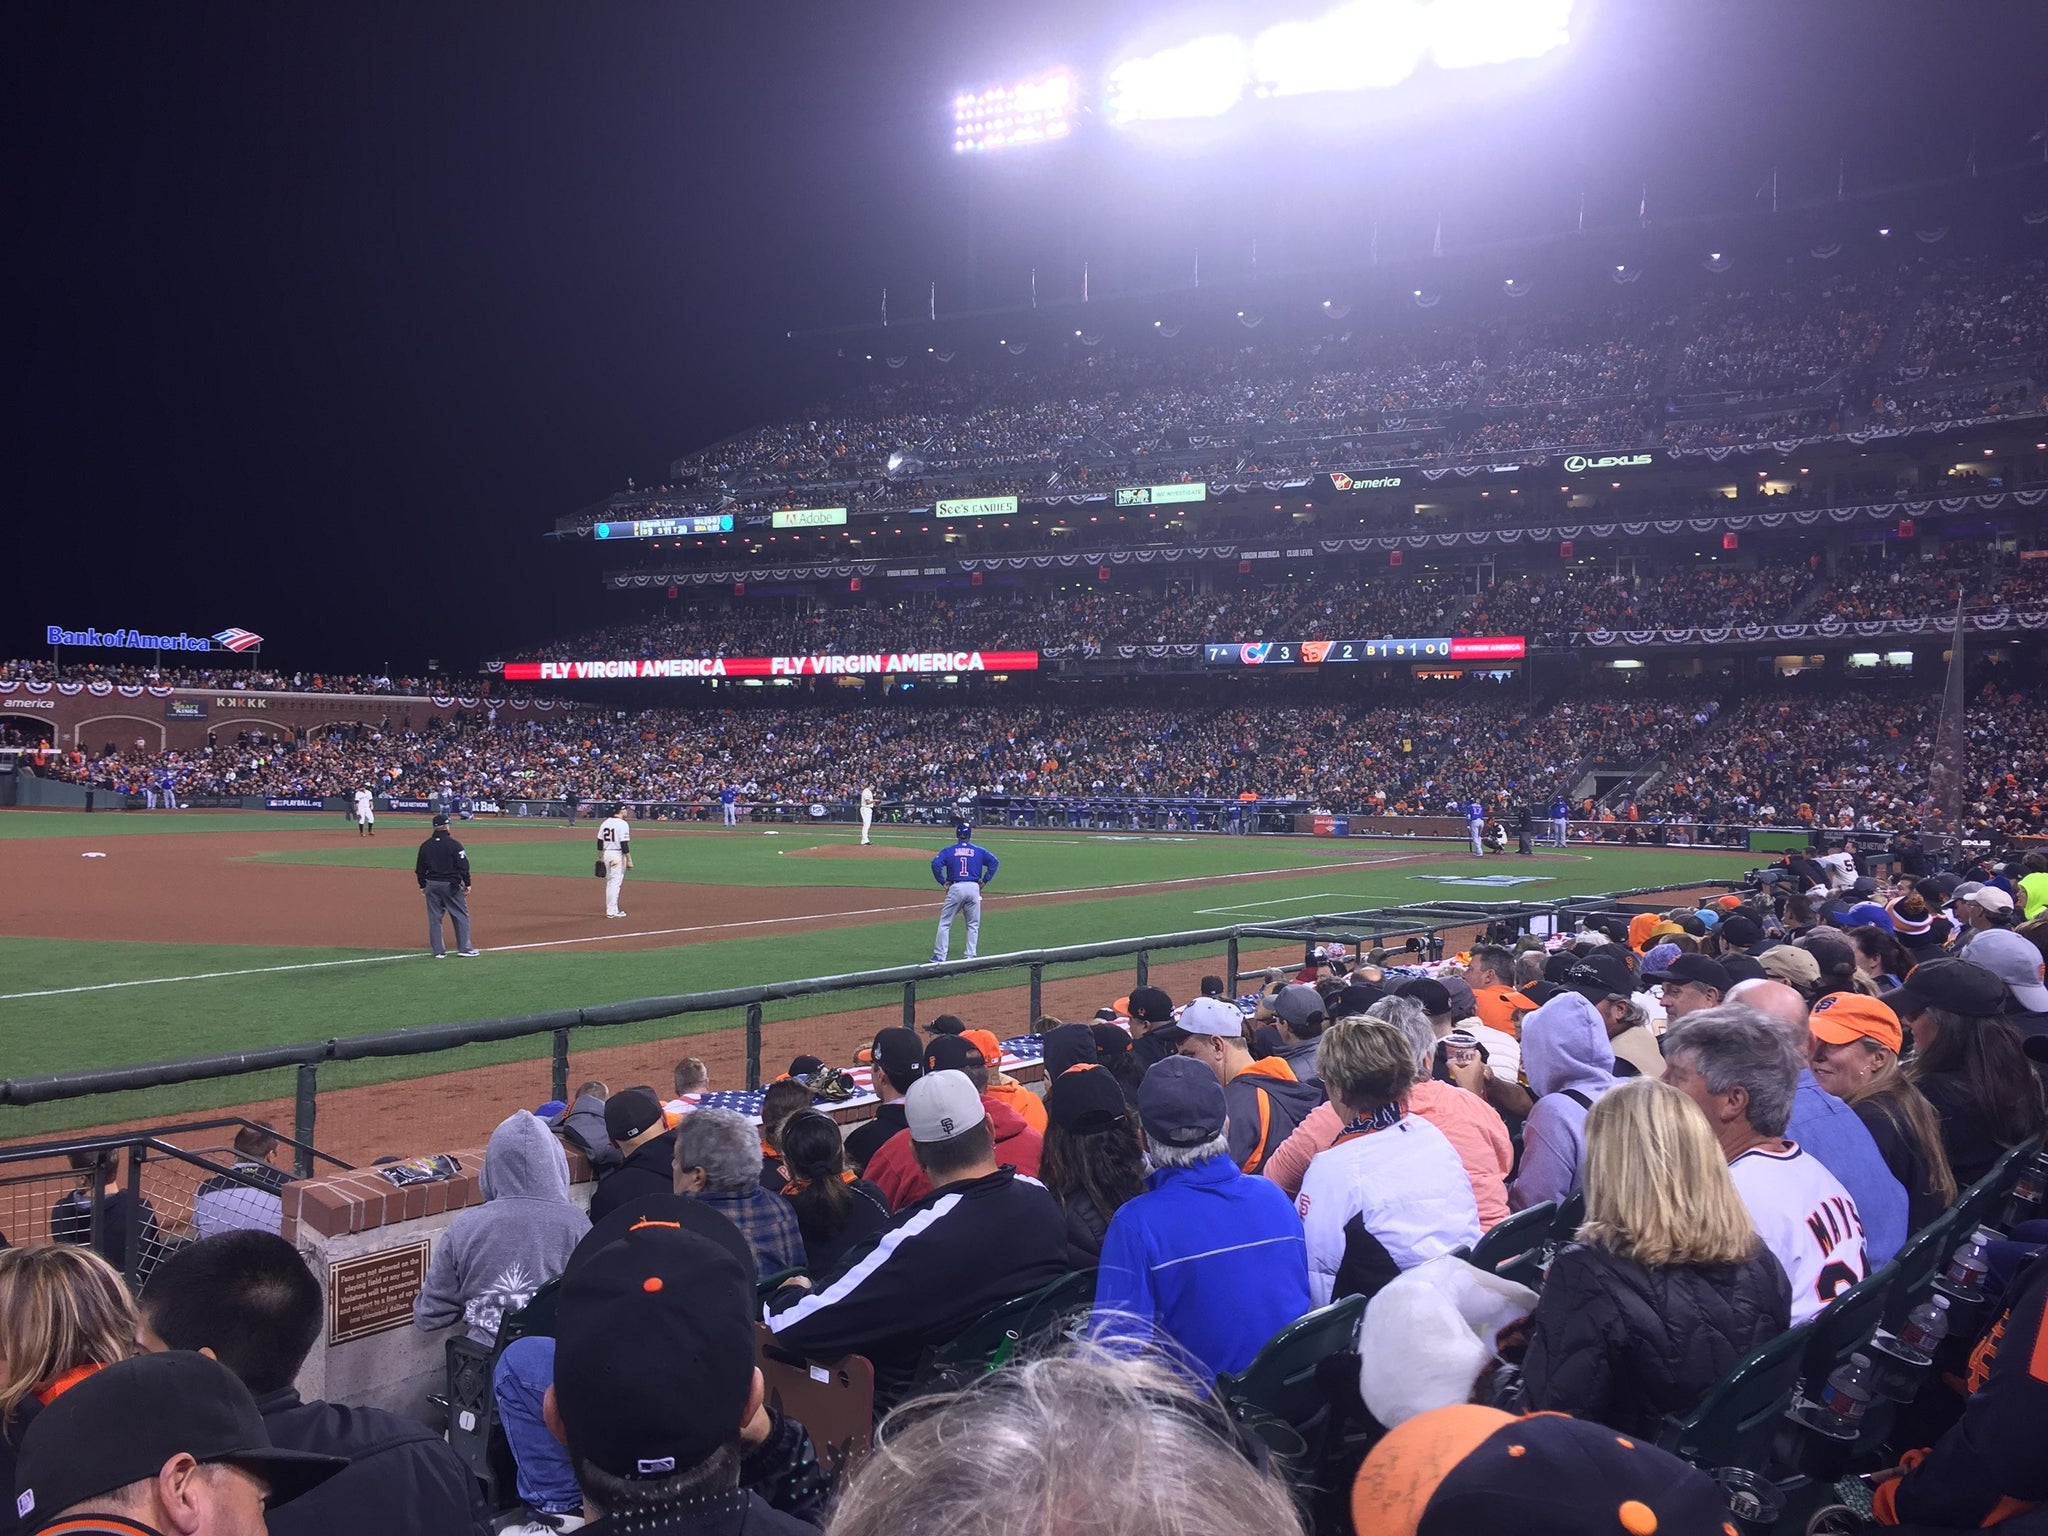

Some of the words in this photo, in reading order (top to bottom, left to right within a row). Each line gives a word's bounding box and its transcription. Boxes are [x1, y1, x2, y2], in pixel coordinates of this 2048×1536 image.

[1587, 454, 1652, 468] LEXUS
[1352, 476, 1401, 489] america
[939, 503, 969, 515] See's
[972, 502, 1013, 512] CANDIES
[799, 512, 833, 524] Adobe
[47, 626, 101, 647] Bank
[101, 629, 125, 648] of
[125, 630, 210, 652] America
[1209, 648, 1219, 661] 7
[1280, 647, 1290, 660] 3
[1342, 645, 1353, 658] 2
[1367, 645, 1375, 656] B
[1380, 644, 1387, 657] 1
[1396, 645, 1405, 655] S
[1410, 643, 1417, 656] 1
[1439, 642, 1449, 656] 0
[540, 662, 573, 680] FLY
[575, 660, 637, 679] VIRGIN
[640, 658, 726, 678] AMERICA
[771, 657, 808, 675] FLY
[810, 655, 882, 674] VIRGIN
[887, 652, 984, 672] AMERICA
[3, 699, 55, 709] america
[603, 828, 615, 842] 21
[960, 857, 969, 876] 1
[941, 1117, 954, 1135] SF
[341, 1275, 355, 1283] Fans
[367, 1268, 377, 1276] not
[378, 1262, 400, 1273] allowed
[340, 1293, 367, 1304] Violators
[368, 1288, 379, 1296] will
[380, 1286, 387, 1294] be
[388, 1277, 419, 1292] prosecuted
[345, 1282, 366, 1294] playing
[368, 1276, 382, 1287] field
[340, 1306, 350, 1315] and
[352, 1301, 373, 1312] subject
[362, 1306, 388, 1320] thousand
